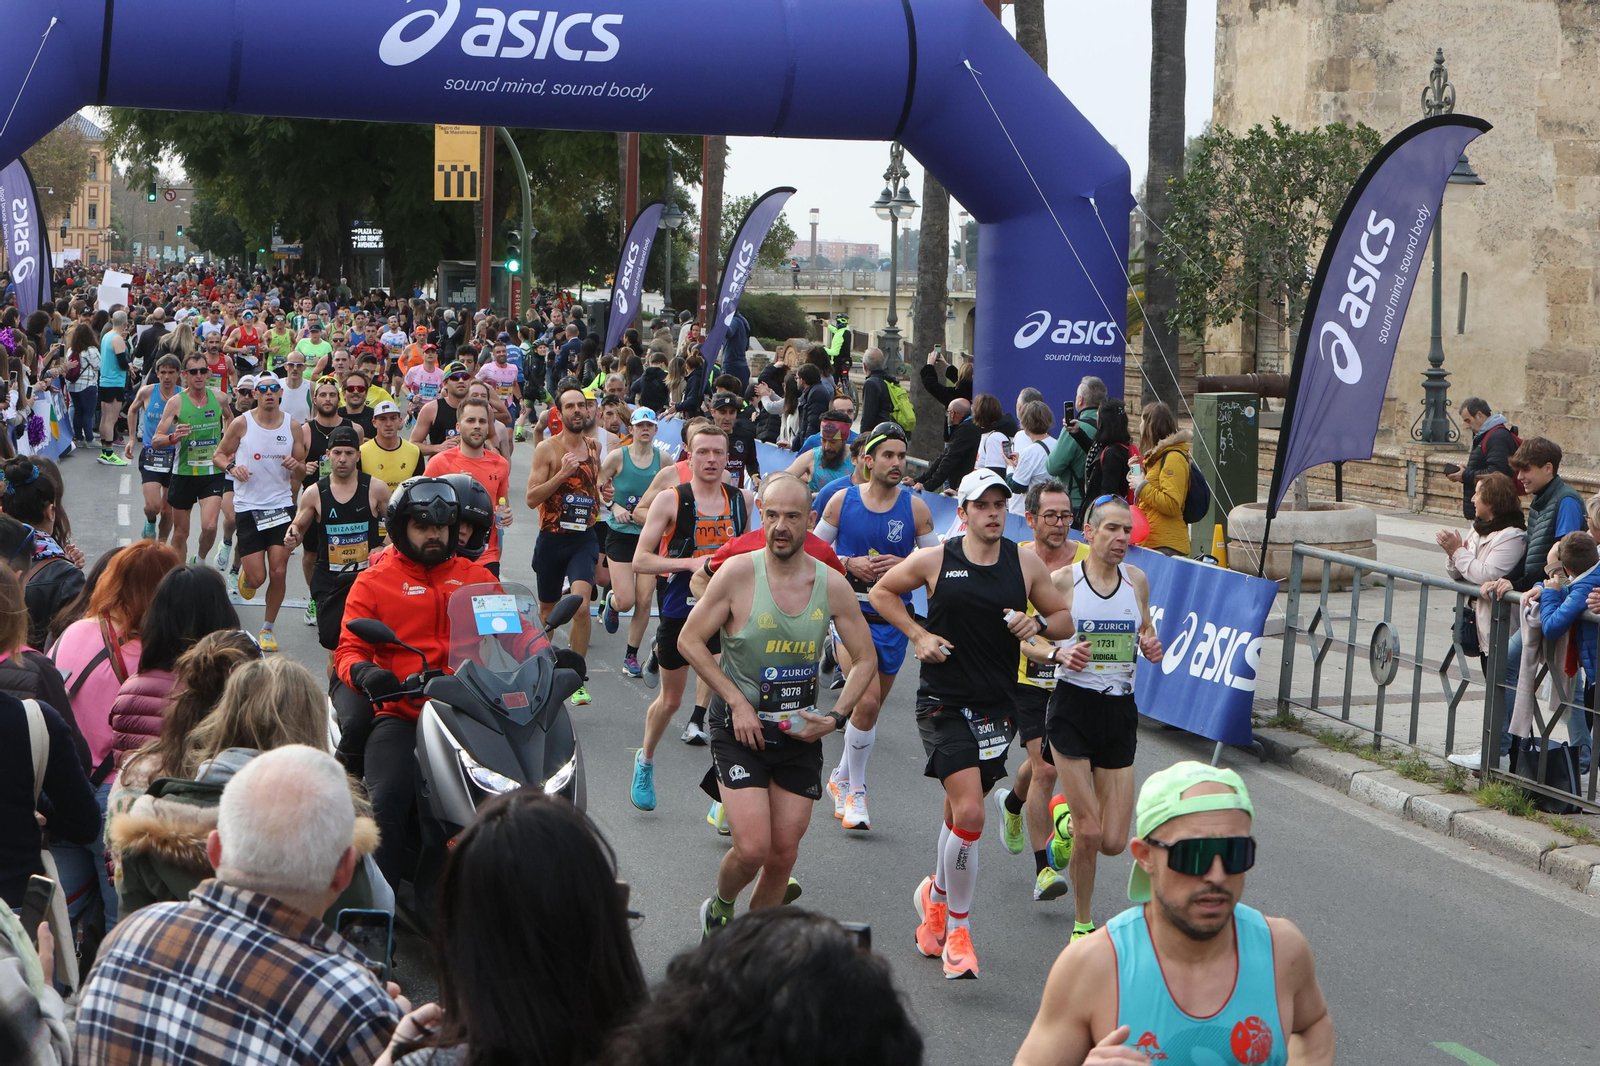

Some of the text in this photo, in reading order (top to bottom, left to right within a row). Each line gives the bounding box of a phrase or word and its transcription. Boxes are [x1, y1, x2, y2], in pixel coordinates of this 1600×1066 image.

[461, 8, 624, 62] asics
[444, 77, 653, 101] sound mind, sound body
[619, 241, 640, 289] asics
[729, 240, 754, 294] asics
[1338, 209, 1395, 329] asics
[1378, 204, 1431, 344] sound mind, sound body
[1051, 320, 1117, 346] asics
[1045, 353, 1122, 365] sound mind, sound body
[341, 536, 364, 544] ZURICH
[945, 570, 969, 578] HOKA
[766, 640, 815, 654] BIKILA
[1189, 622, 1263, 692] asics
[782, 668, 814, 677] ZURICH
[781, 687, 801, 697] 3078
[781, 702, 800, 710] CHULI
